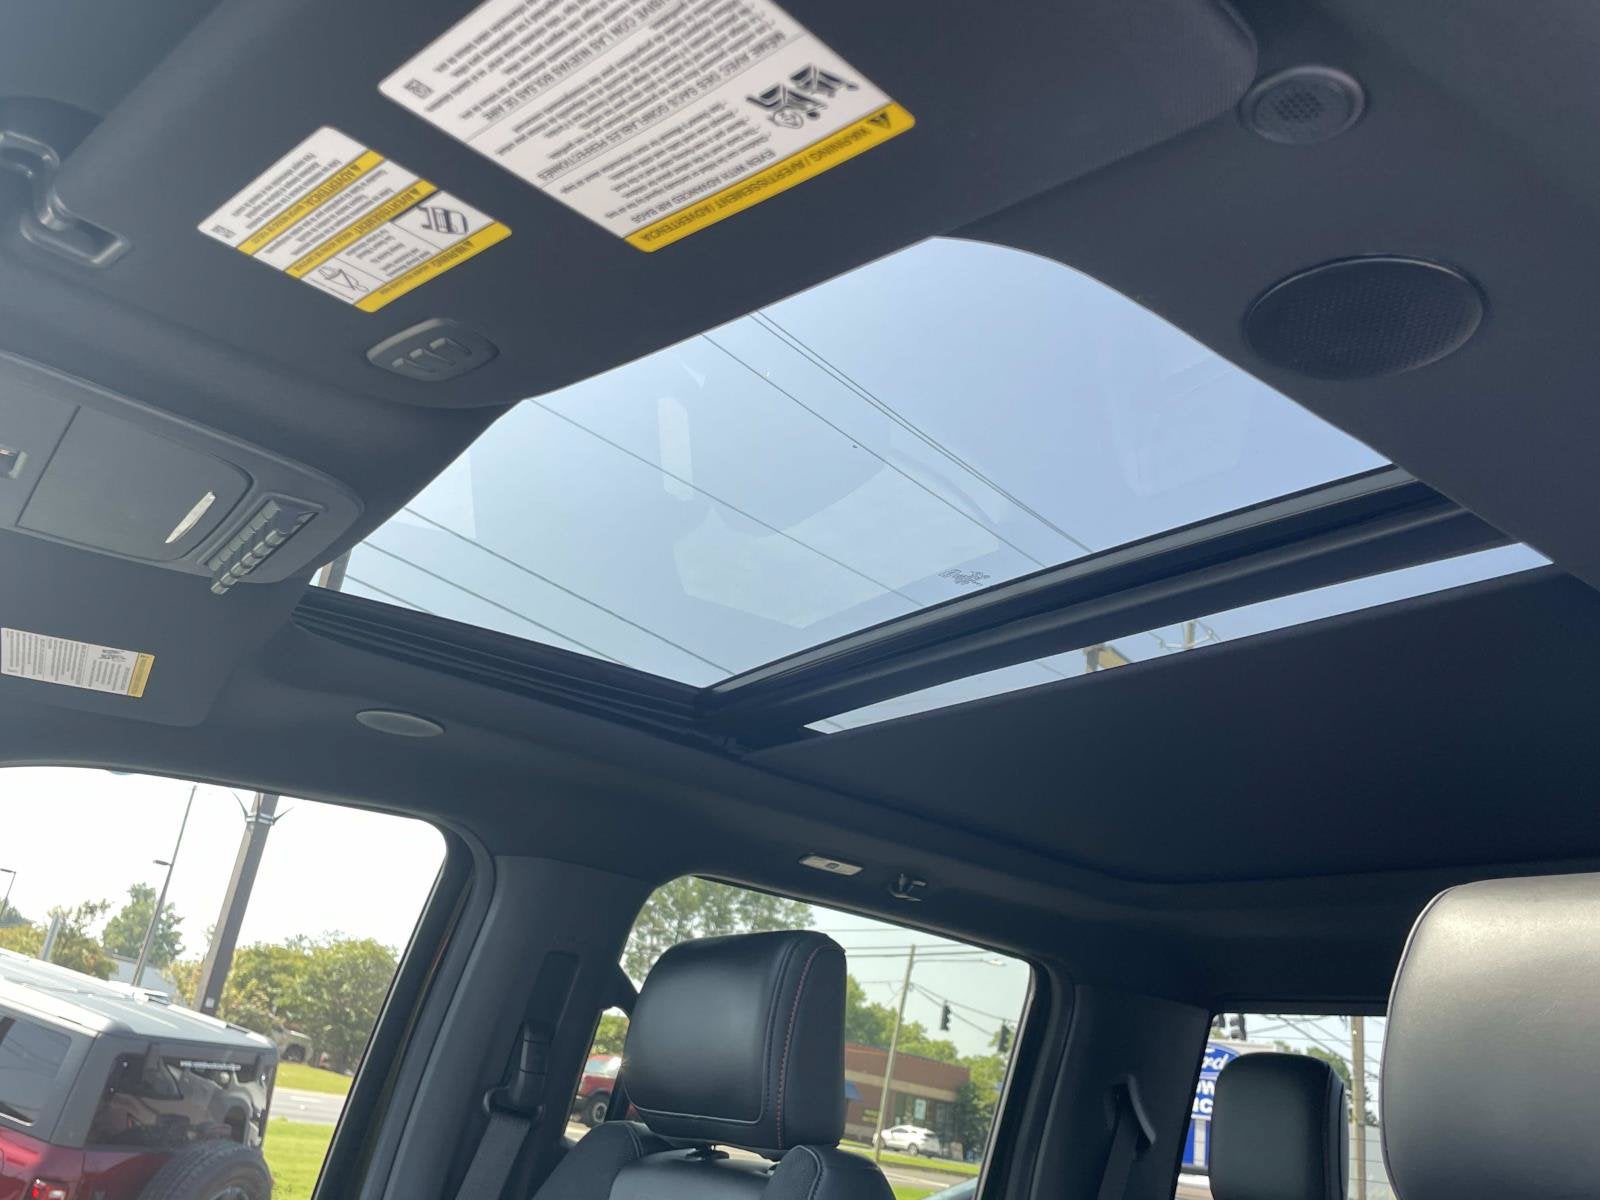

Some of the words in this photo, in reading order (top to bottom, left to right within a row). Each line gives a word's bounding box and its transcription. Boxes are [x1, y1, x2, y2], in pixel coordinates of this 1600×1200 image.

[608, 15, 641, 38] CON
[587, 33, 615, 52] LAS
[549, 47, 594, 77] NUEVAS
[718, 53, 754, 76] AVEC
[513, 72, 556, 101] BOLSAS
[694, 72, 724, 90] DES
[500, 96, 521, 110] DE
[481, 104, 509, 122] AIRE
[807, 125, 873, 162] WARNING
[745, 150, 778, 168] EVEN
[718, 164, 749, 181] WITH
[669, 176, 724, 205] ADVANCED
[654, 200, 676, 212] AIR
[629, 208, 660, 225] BAGS
